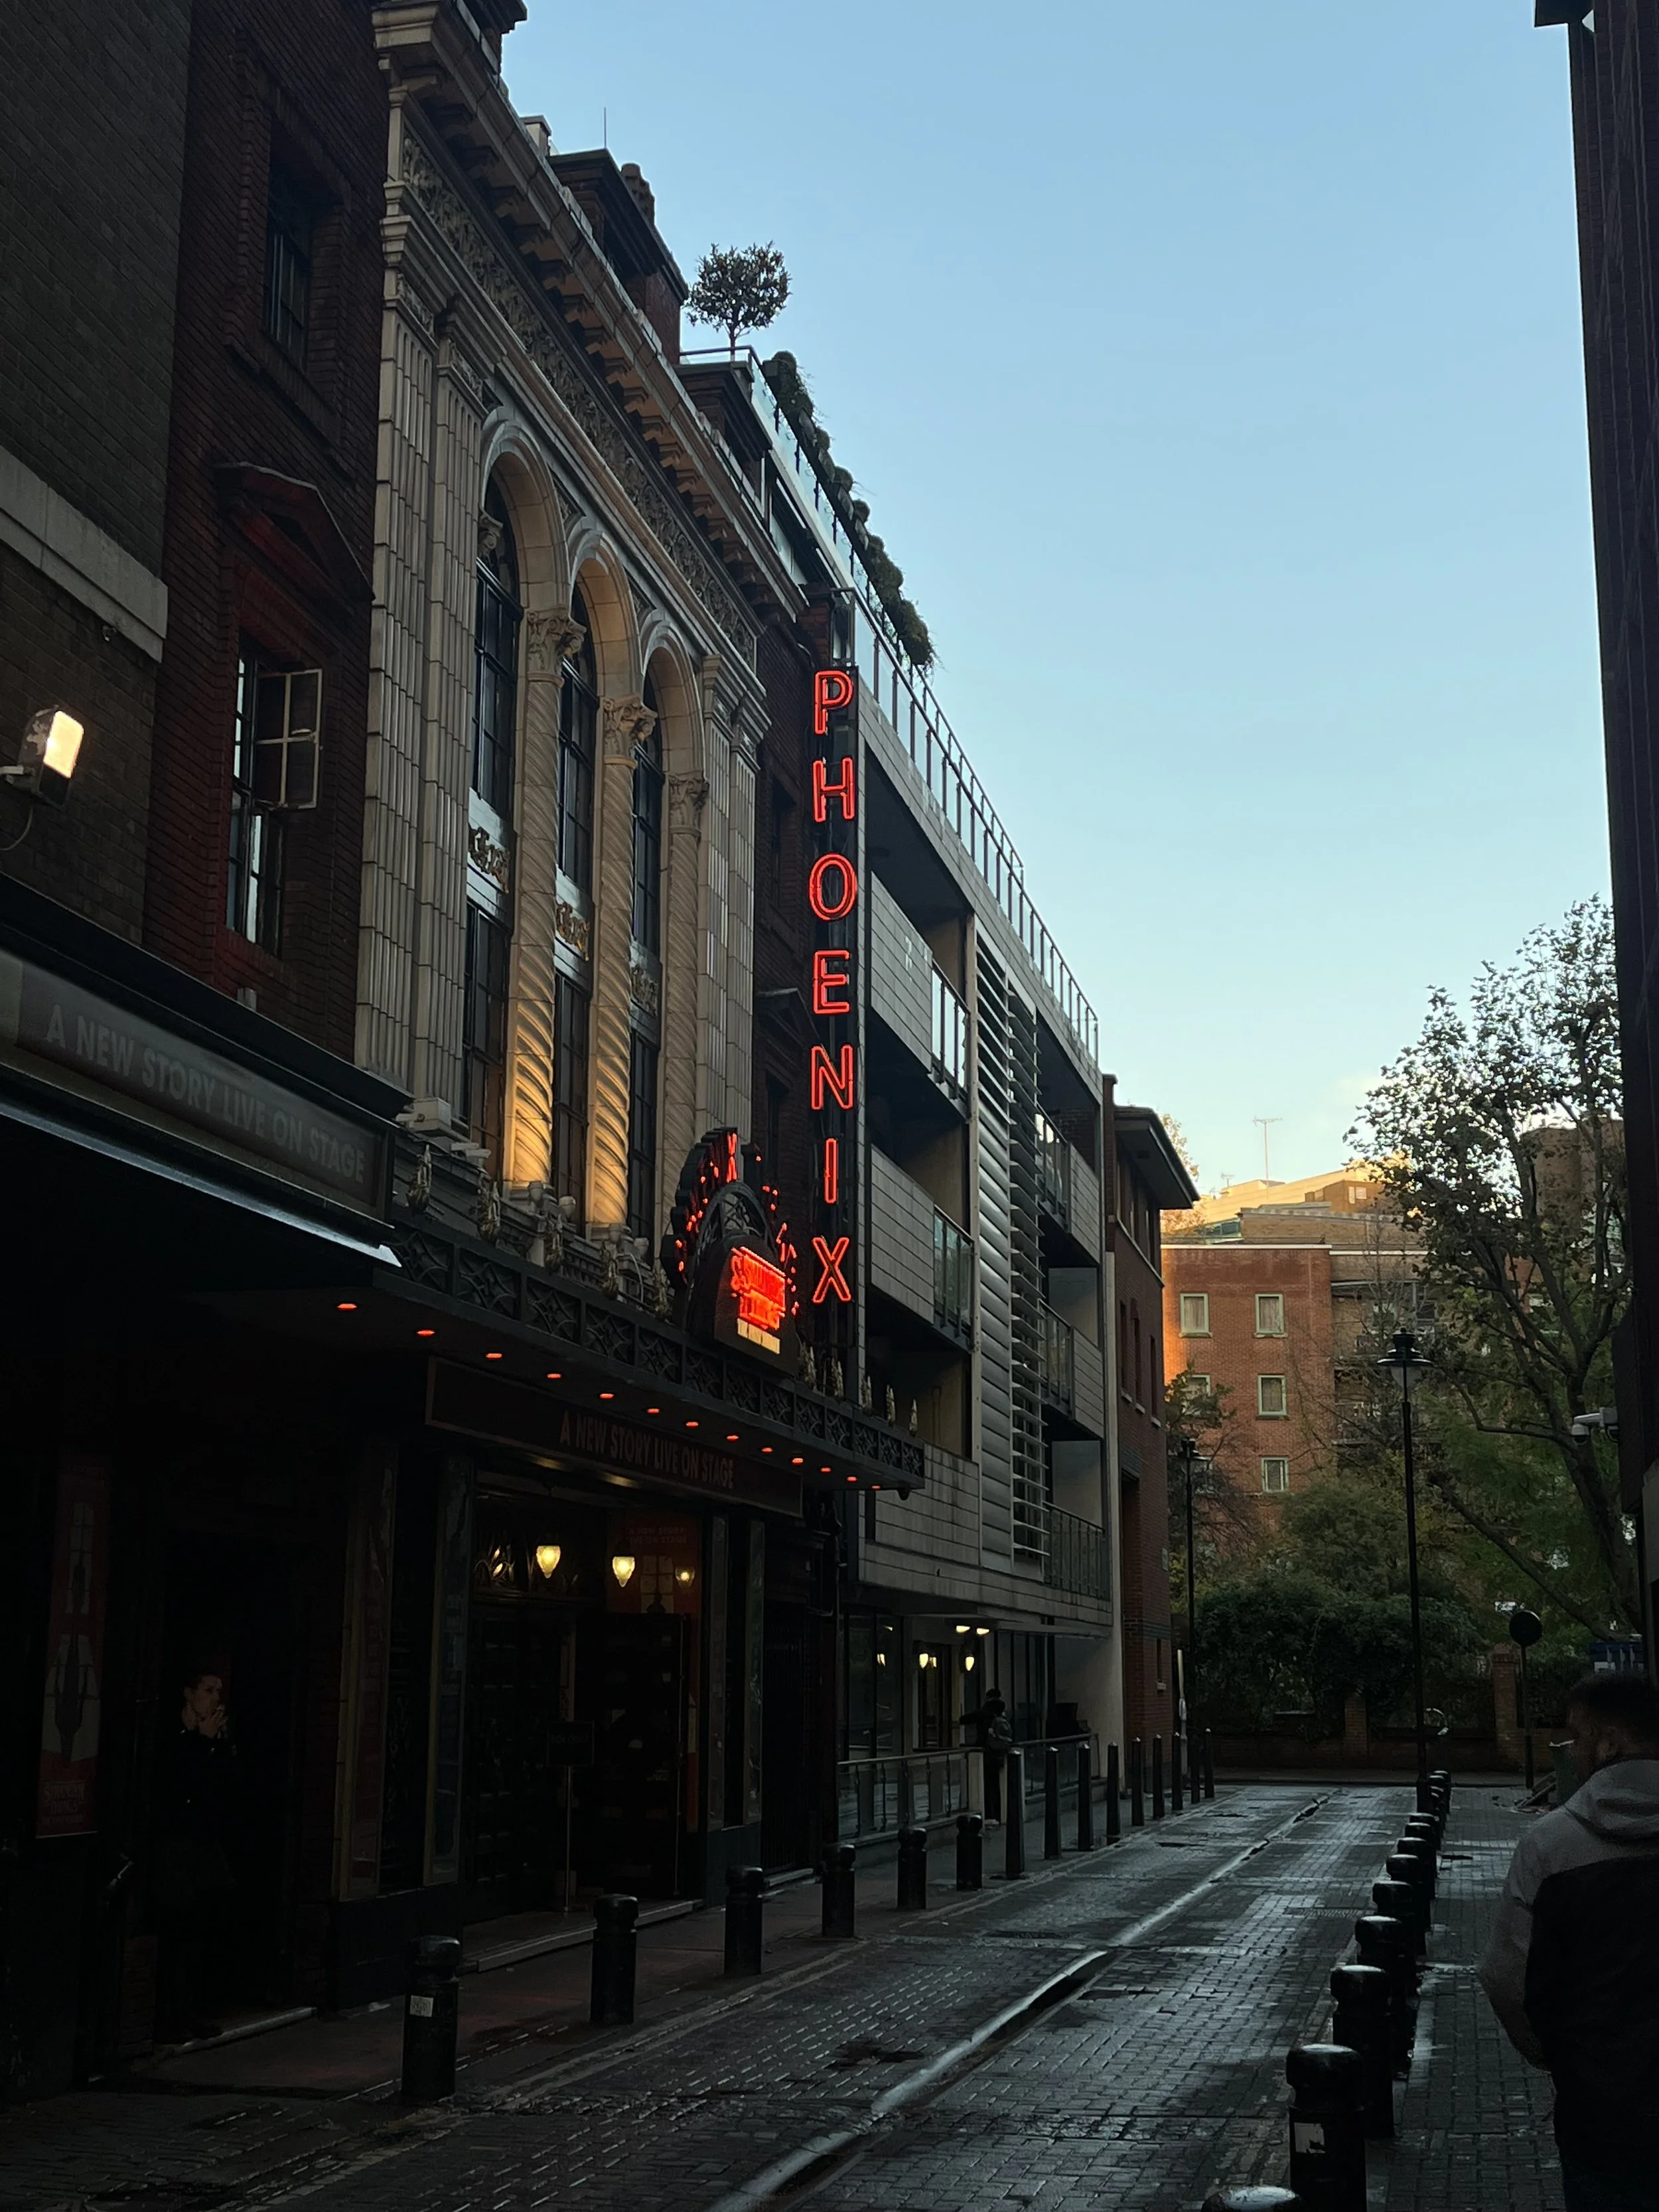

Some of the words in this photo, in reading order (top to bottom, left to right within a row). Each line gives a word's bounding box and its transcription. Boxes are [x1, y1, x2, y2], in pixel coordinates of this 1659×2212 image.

[809, 670, 857, 1303] PHOENIX
[46, 1004, 66, 1049] A
[76, 1015, 134, 1078] NEW
[142, 1047, 216, 1114] STORY
[223, 1084, 265, 1139] LIVE
[273, 1109, 303, 1154] ON
[309, 1127, 364, 1185] STAGE
[559, 1409, 571, 1446] A
[575, 1413, 607, 1455] NEW
[610, 1424, 651, 1468] STORY
[654, 1437, 678, 1474] LIVE
[682, 1445, 698, 1480] ON
[701, 1451, 734, 1490] STAGE
